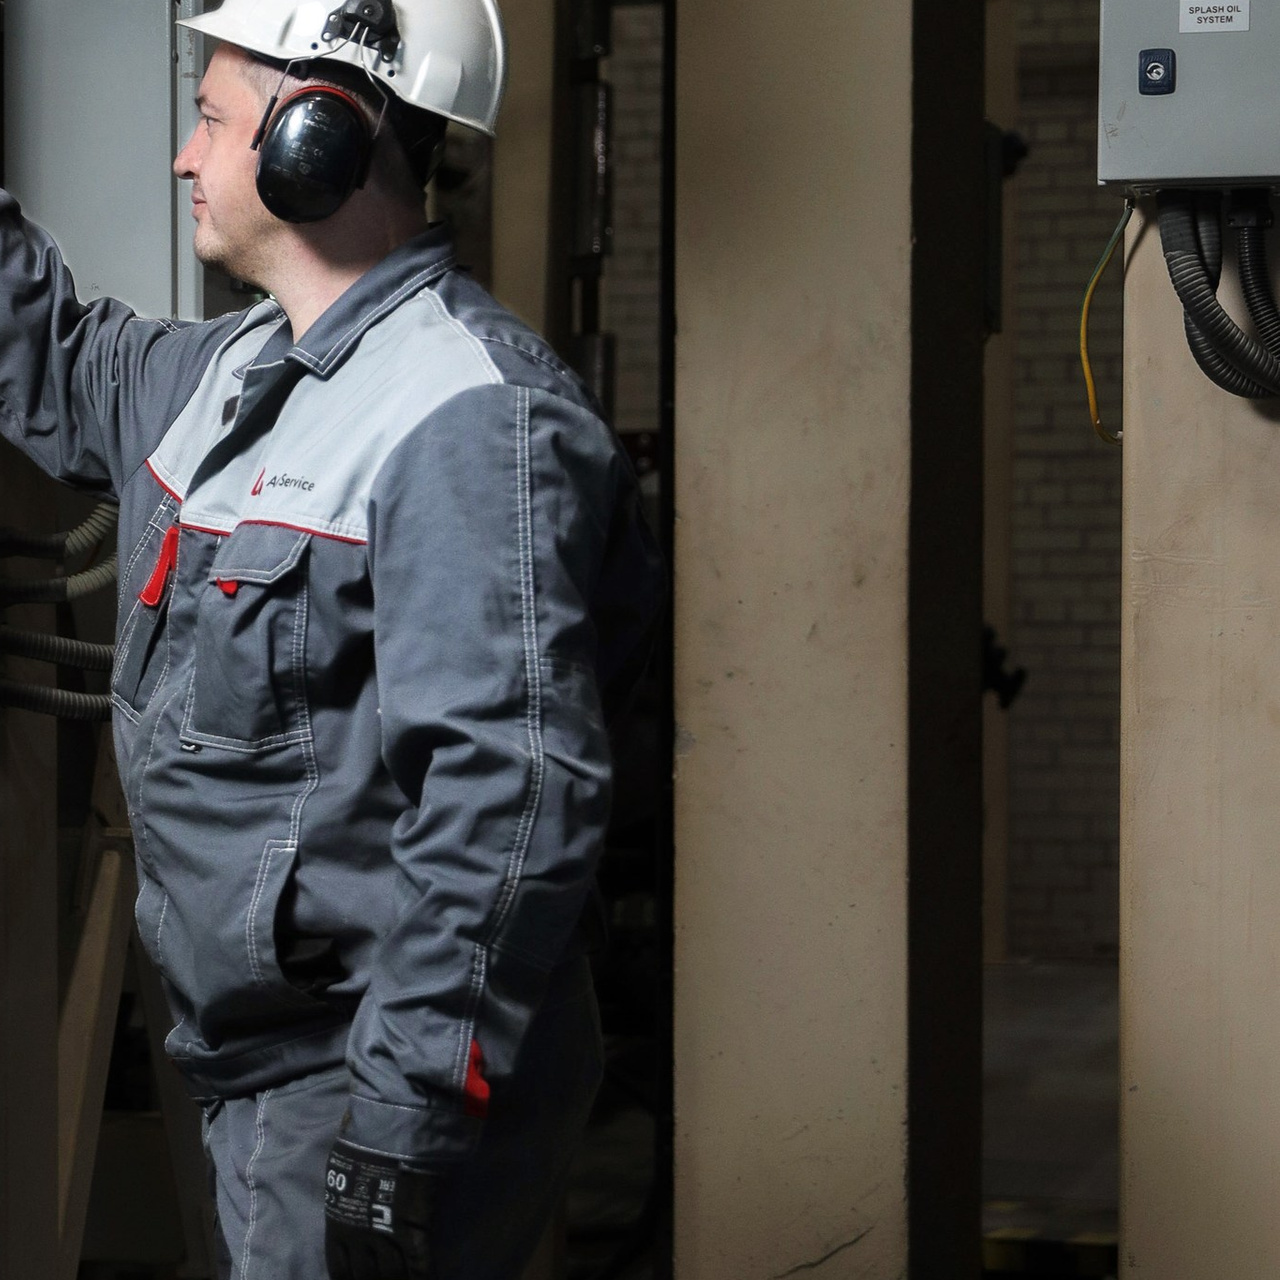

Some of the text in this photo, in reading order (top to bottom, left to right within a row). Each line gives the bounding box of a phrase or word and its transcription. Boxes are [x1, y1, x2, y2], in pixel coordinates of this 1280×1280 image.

[1188, 4, 1242, 15] SPLASH OIL
[1196, 15, 1234, 24] SYSTEM
